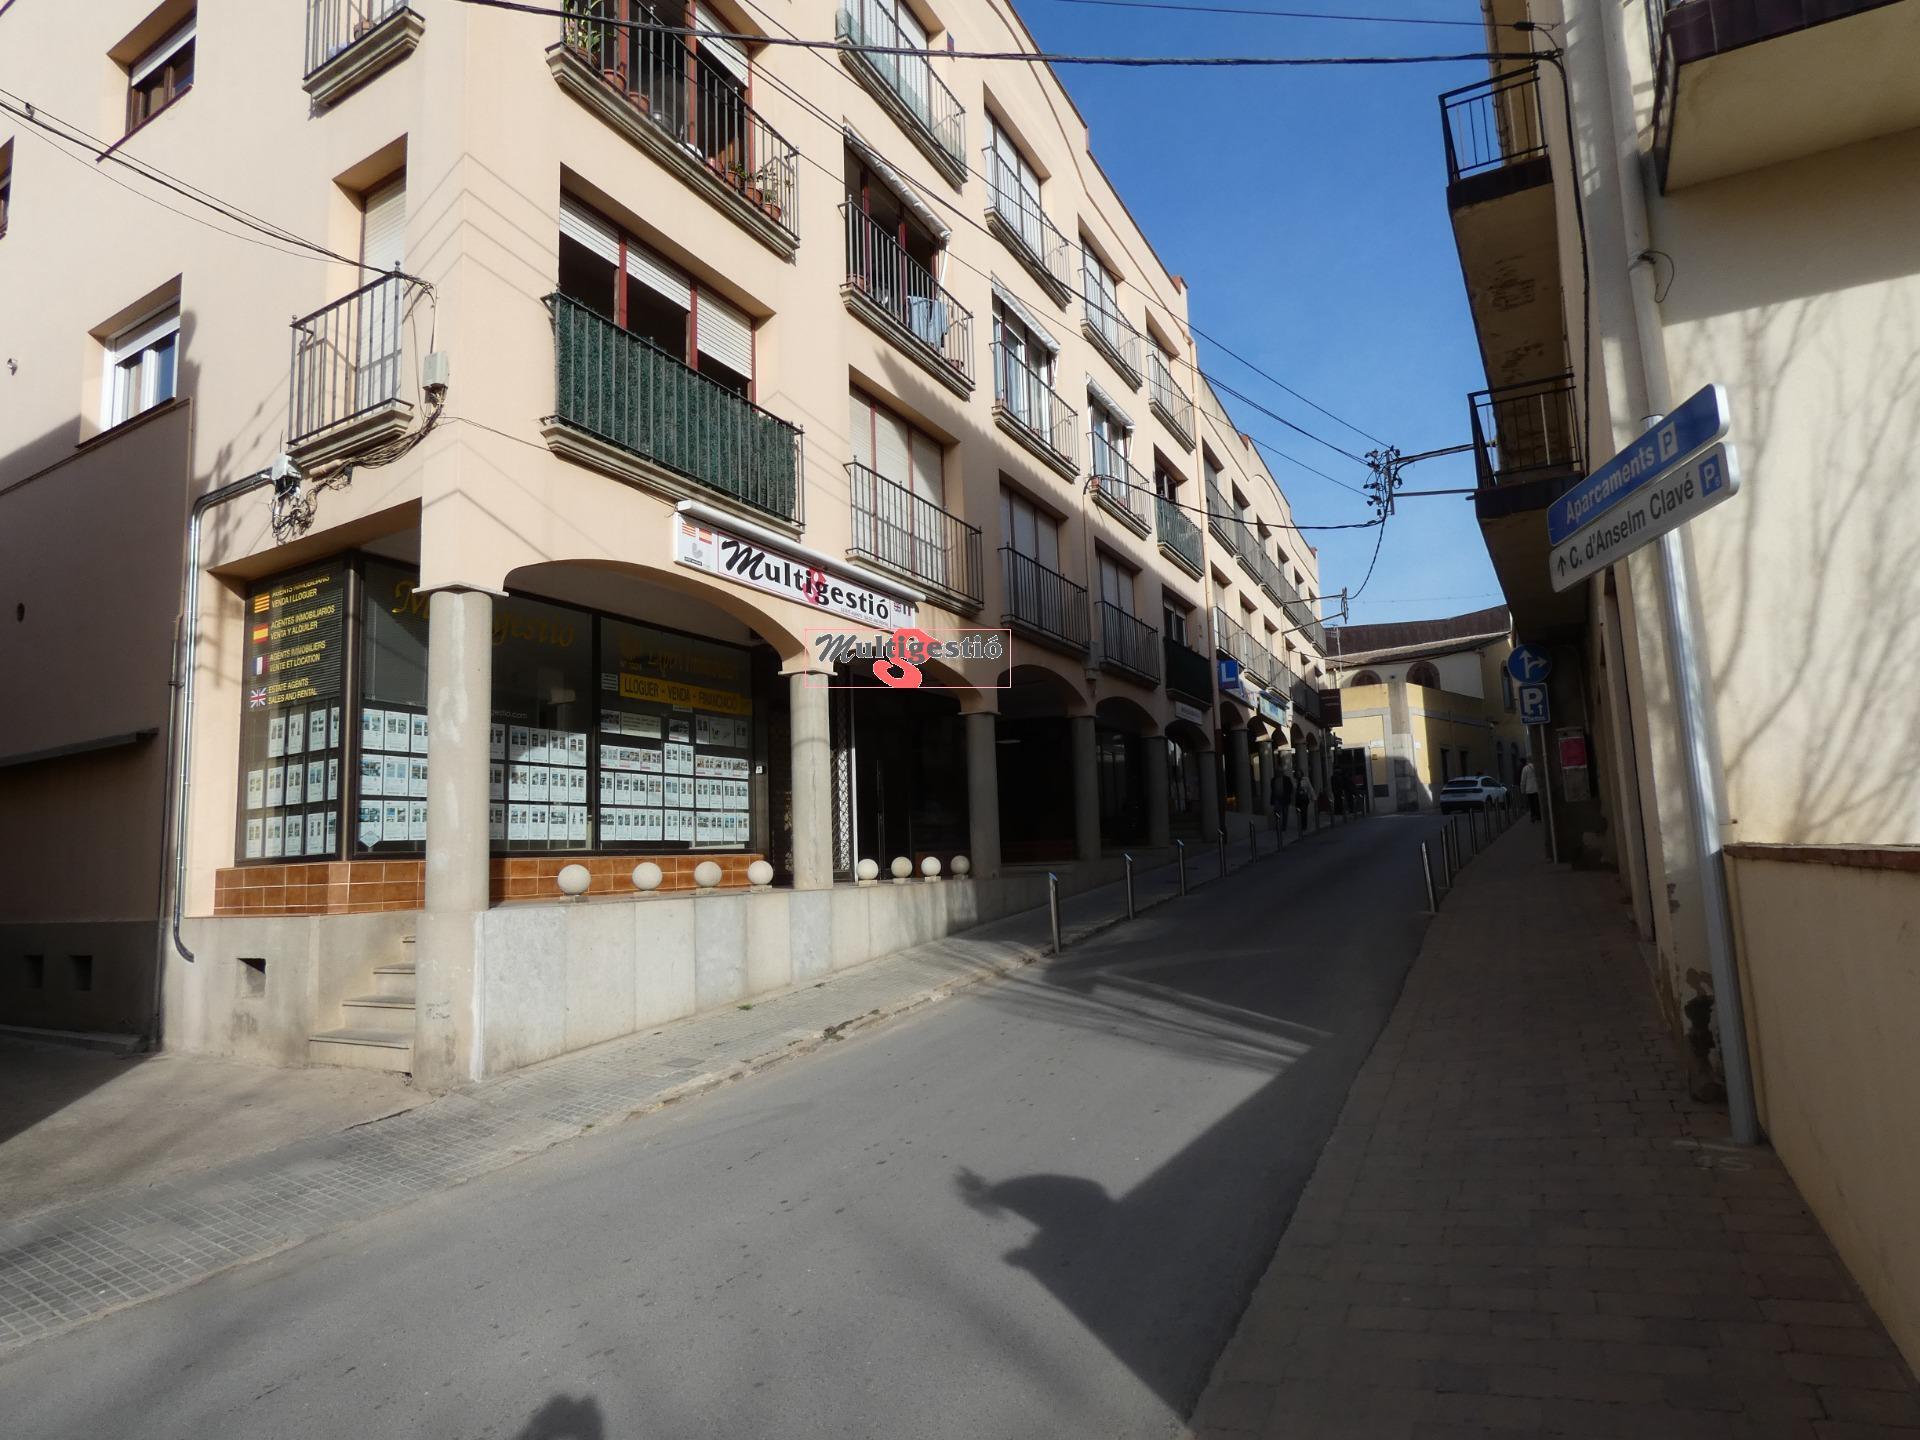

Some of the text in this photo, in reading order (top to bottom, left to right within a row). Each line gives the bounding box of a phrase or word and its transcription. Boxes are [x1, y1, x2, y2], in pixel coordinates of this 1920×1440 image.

[1566, 446, 1655, 525] Aparcaments
[1569, 546, 1583, 569] C.
[1585, 508, 1648, 560] d'Anselm
[1649, 471, 1695, 520] Clavé
[721, 540, 890, 620] Multigestió
[292, 588, 318, 602] LLOGUER
[294, 653, 321, 667] LOCATION
[624, 677, 659, 698] LLOGUER
[1522, 688, 1542, 714] P
